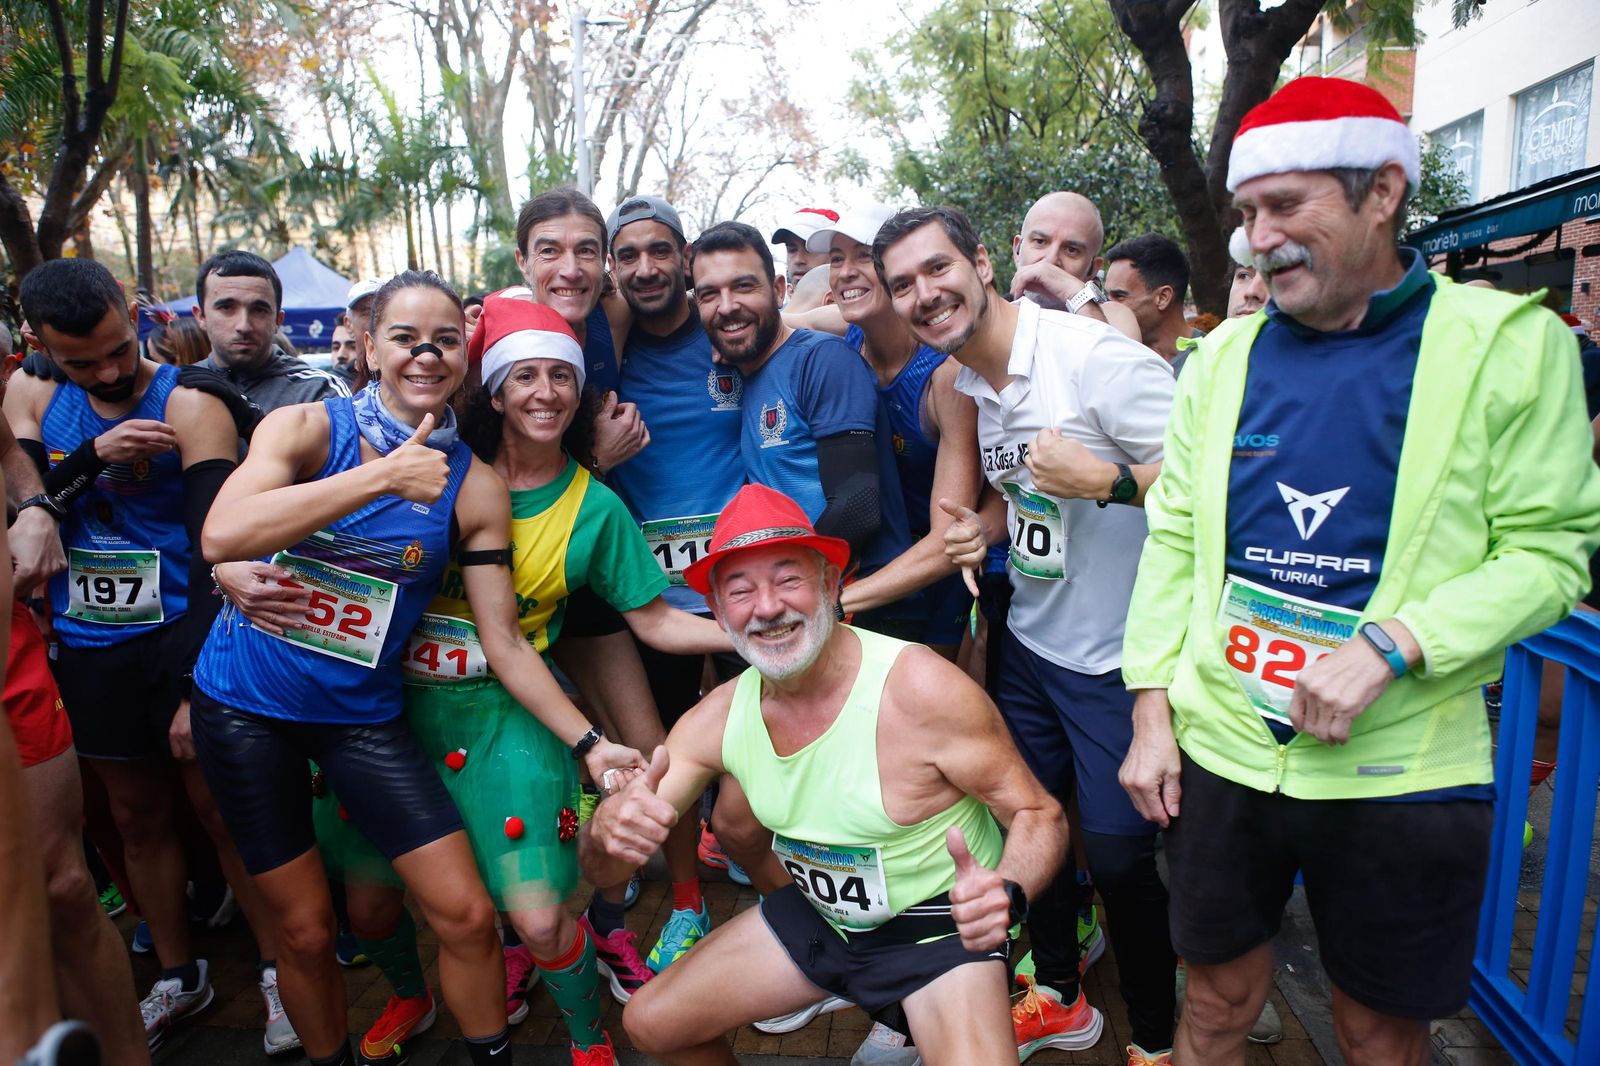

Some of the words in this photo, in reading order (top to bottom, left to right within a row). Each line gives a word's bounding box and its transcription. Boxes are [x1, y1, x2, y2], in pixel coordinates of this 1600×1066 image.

[1530, 116, 1577, 150] CENIT
[1422, 230, 1459, 253] marieta
[1233, 433, 1281, 448] VOS
[983, 447, 995, 472] La
[54, 474, 88, 502] KIPRUN
[1245, 546, 1371, 574] CUPRA
[76, 575, 143, 605] 197
[334, 576, 373, 598] NAVIDAD
[1270, 567, 1329, 588] TURIAL
[1247, 598, 1298, 630] CARRERA
[1225, 624, 1332, 689] 82
[819, 850, 856, 867] NAVIDAD
[784, 860, 871, 911] 604
